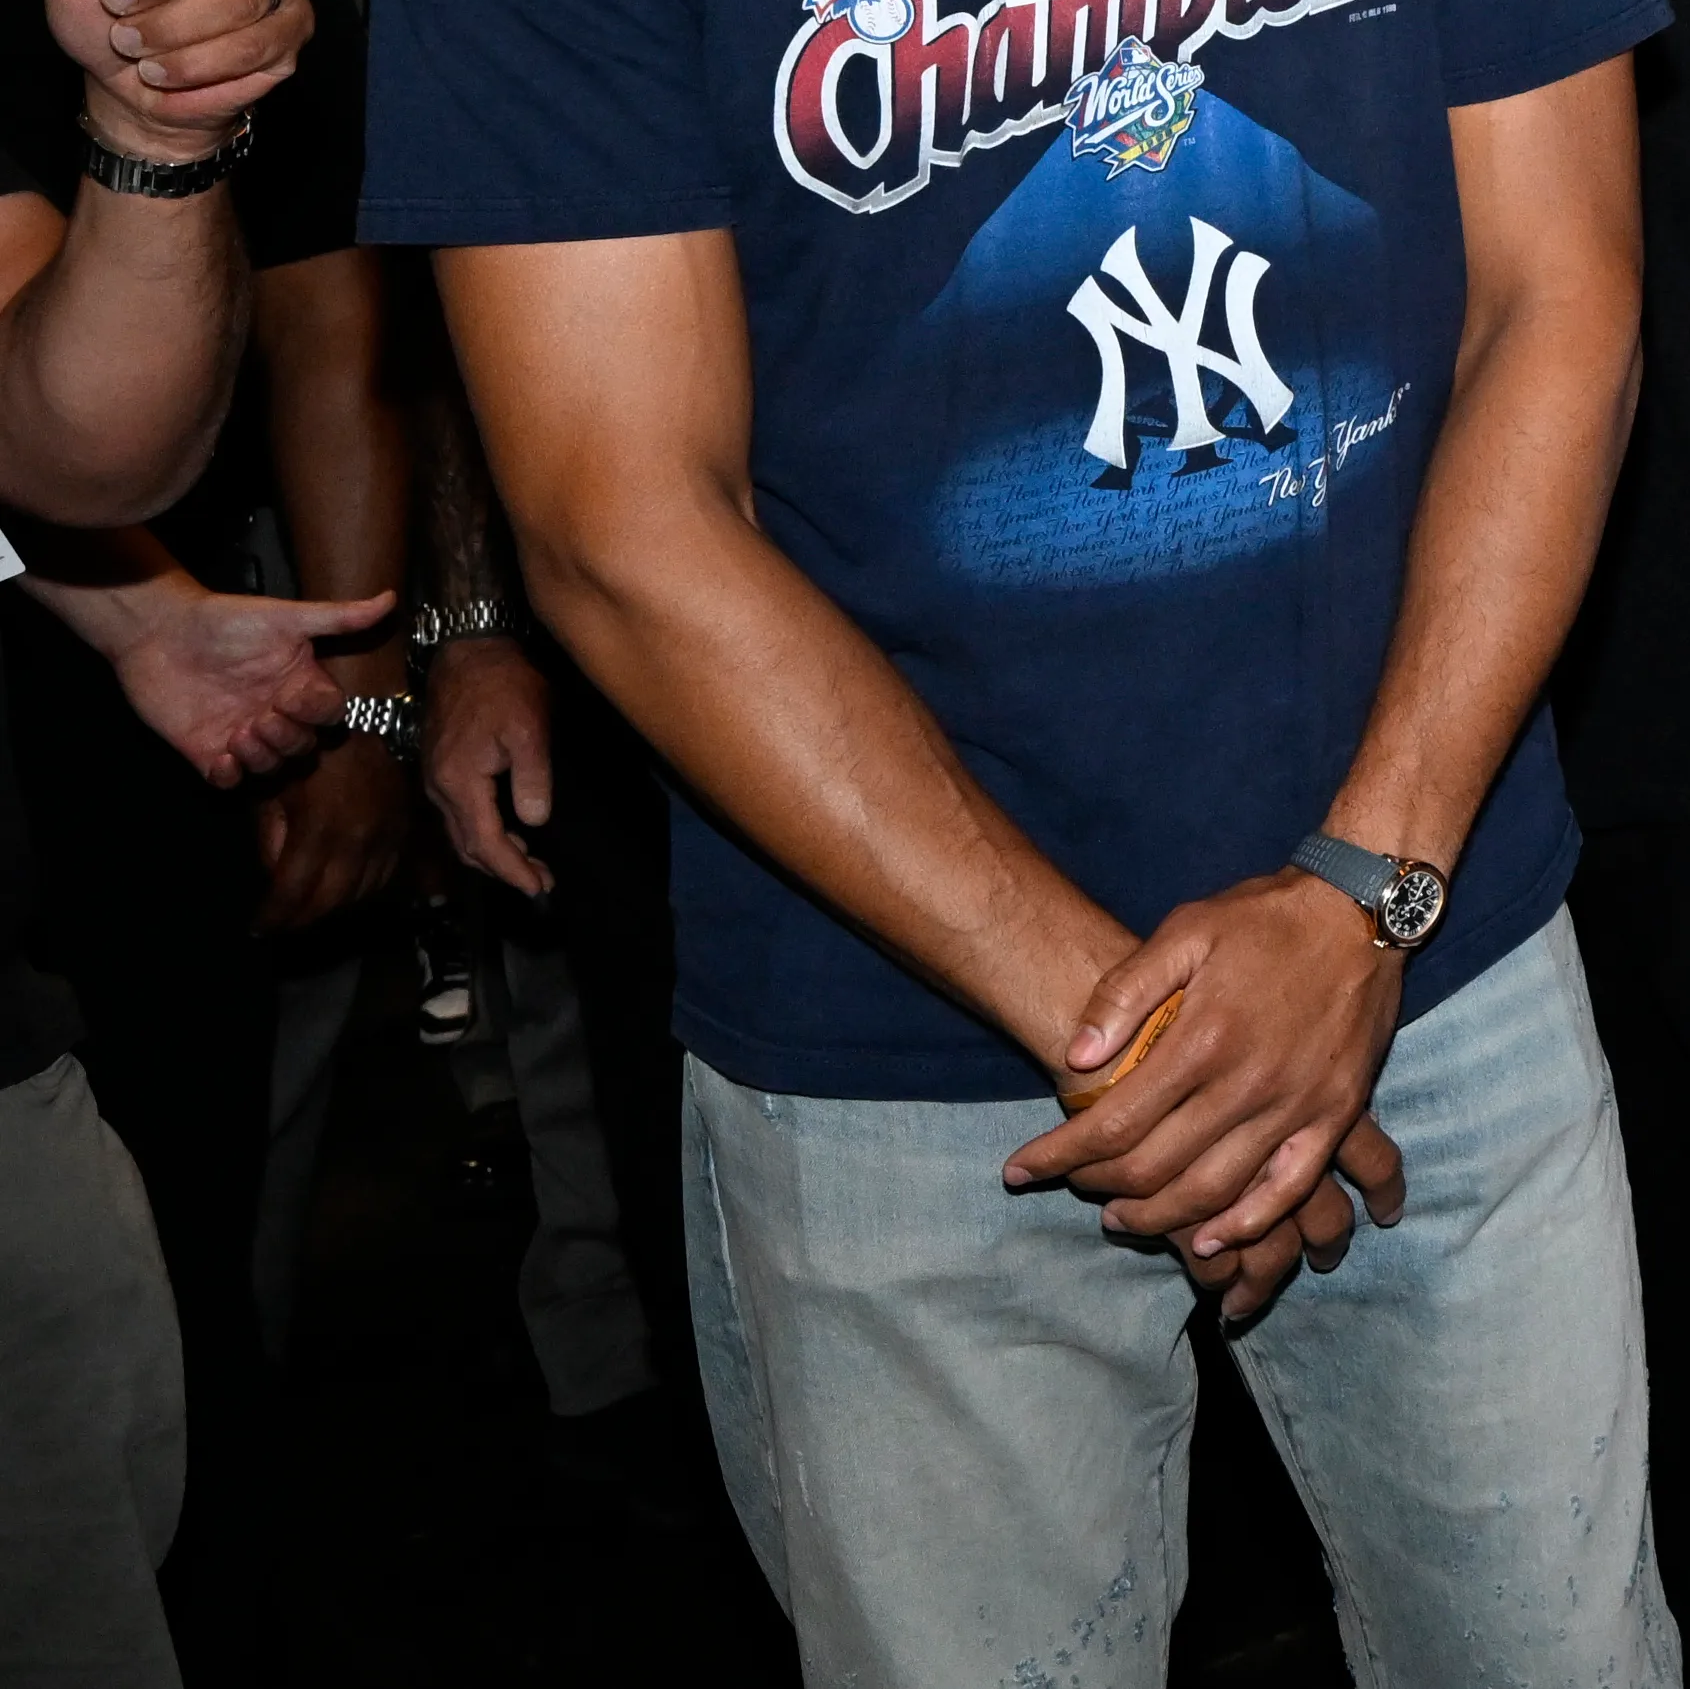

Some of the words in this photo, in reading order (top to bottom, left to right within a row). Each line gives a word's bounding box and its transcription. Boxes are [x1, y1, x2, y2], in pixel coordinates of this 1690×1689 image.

[1070, 71, 1156, 127] World
[1145, 62, 1202, 127] Series
[1066, 216, 1294, 470] NY
[1333, 387, 1404, 472] Yank
